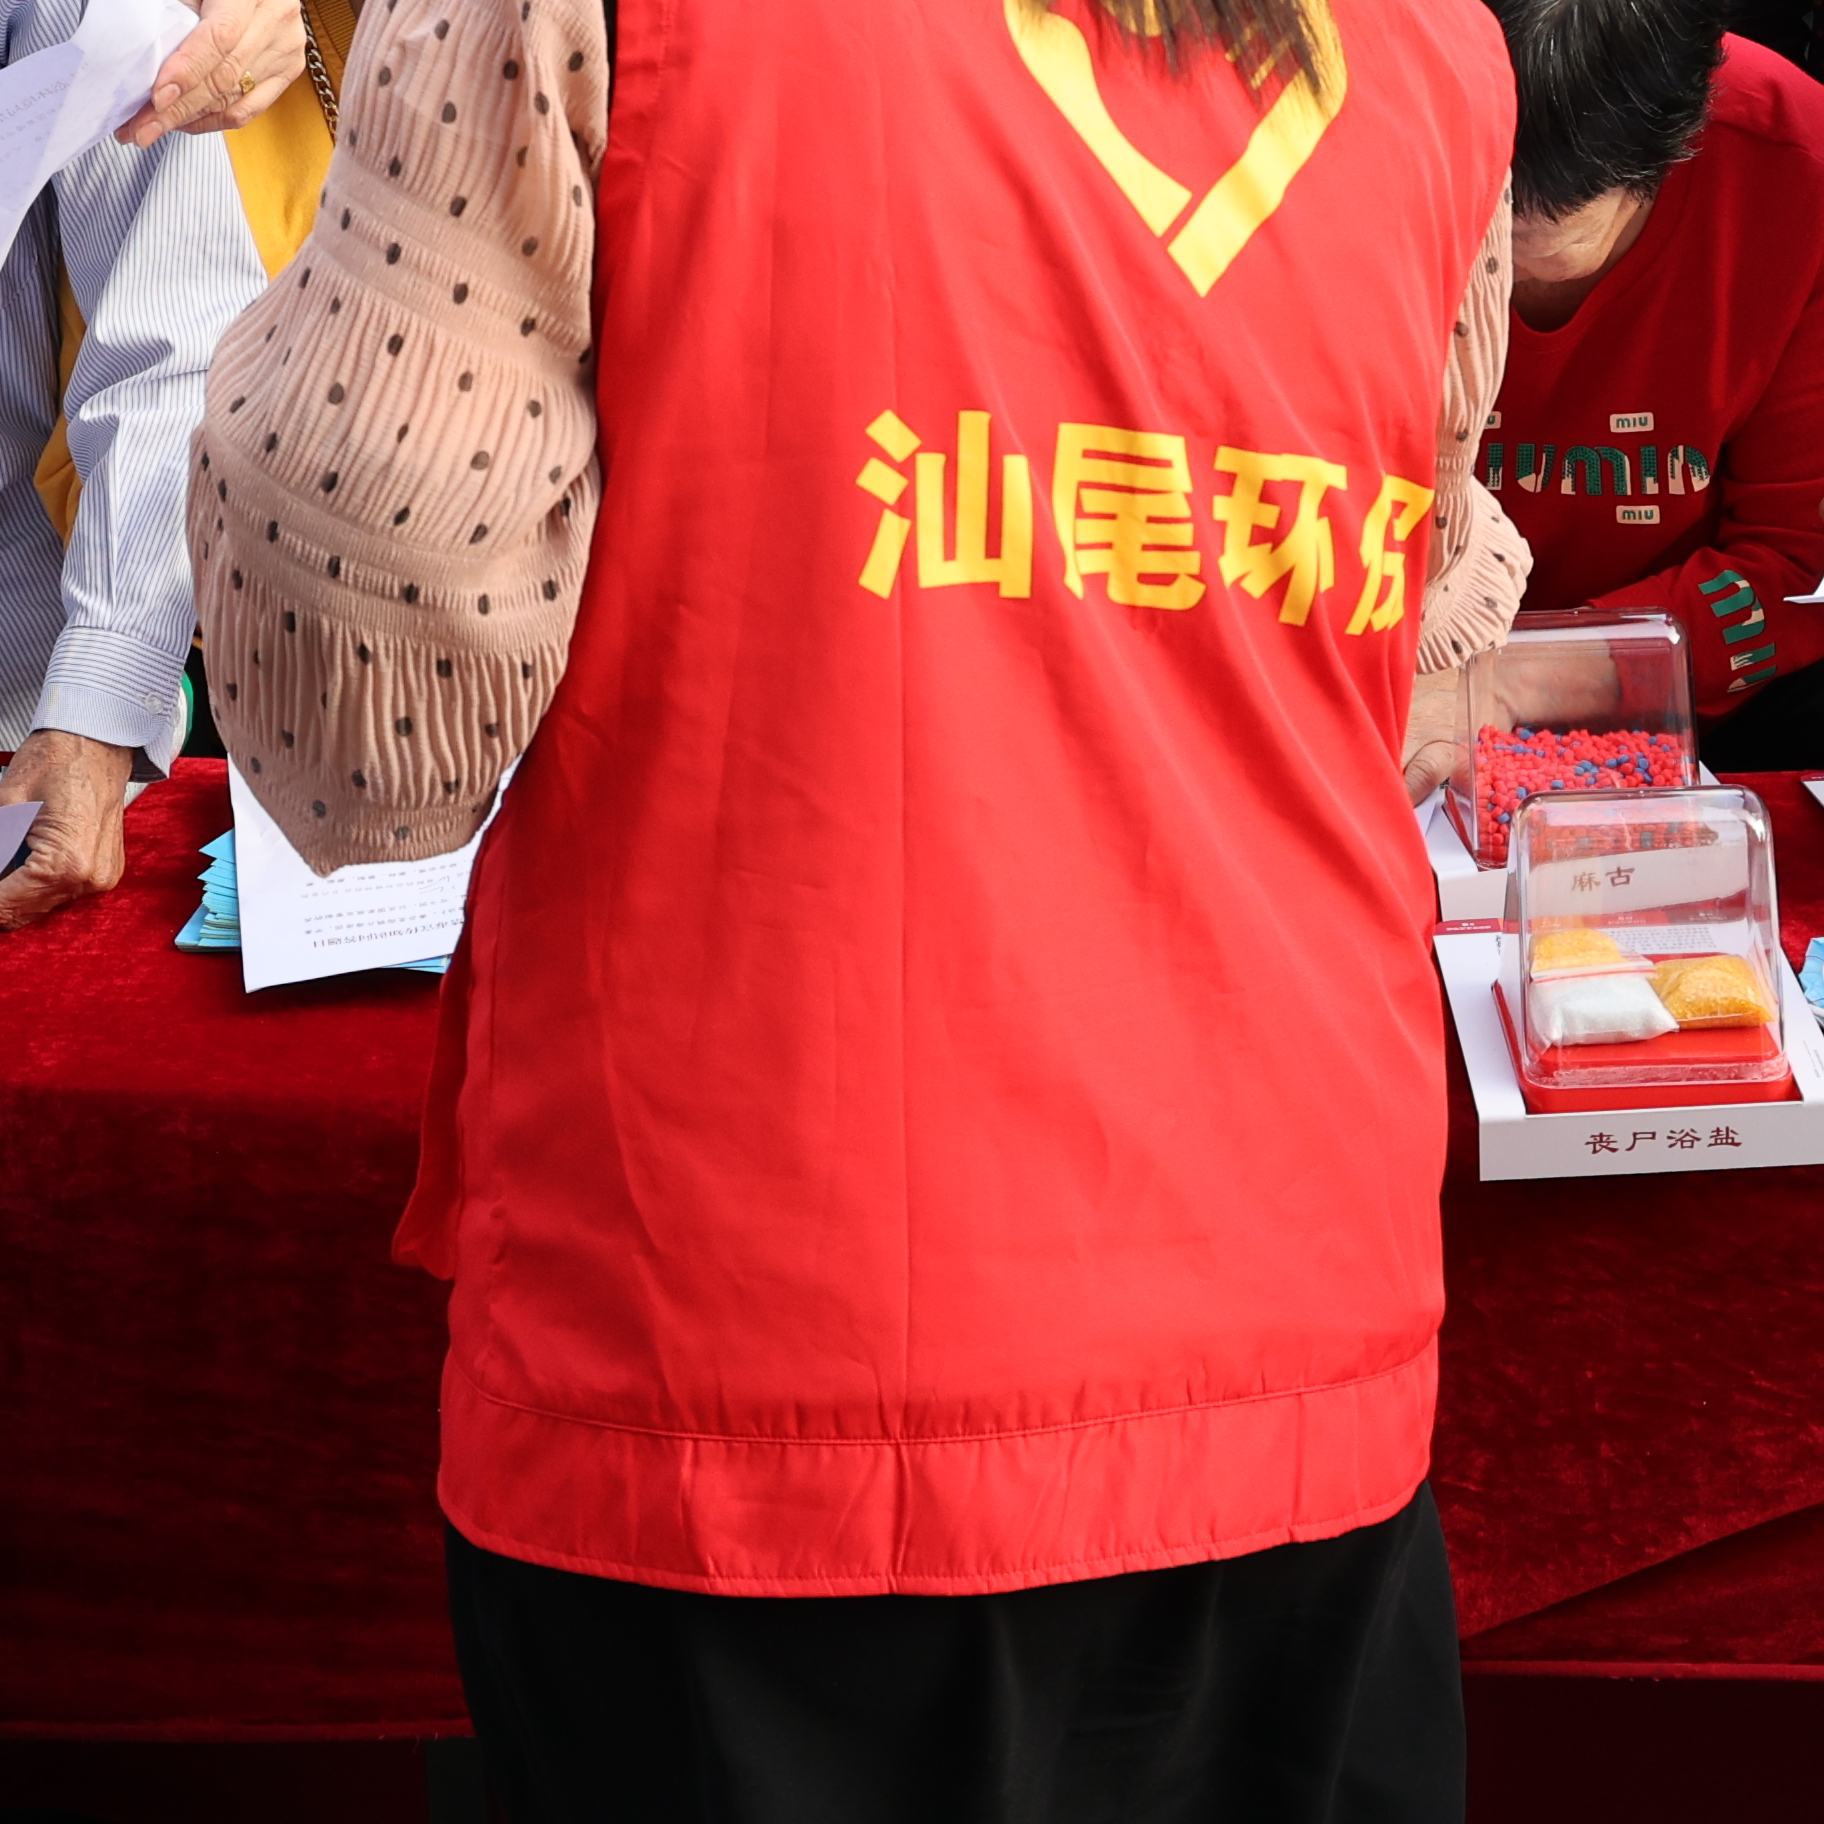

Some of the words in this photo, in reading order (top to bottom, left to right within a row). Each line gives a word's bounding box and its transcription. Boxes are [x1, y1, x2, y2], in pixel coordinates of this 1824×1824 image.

[1570, 866, 1635, 892] 麻古
[1584, 1125, 1744, 1156] 丧尸浴盐
